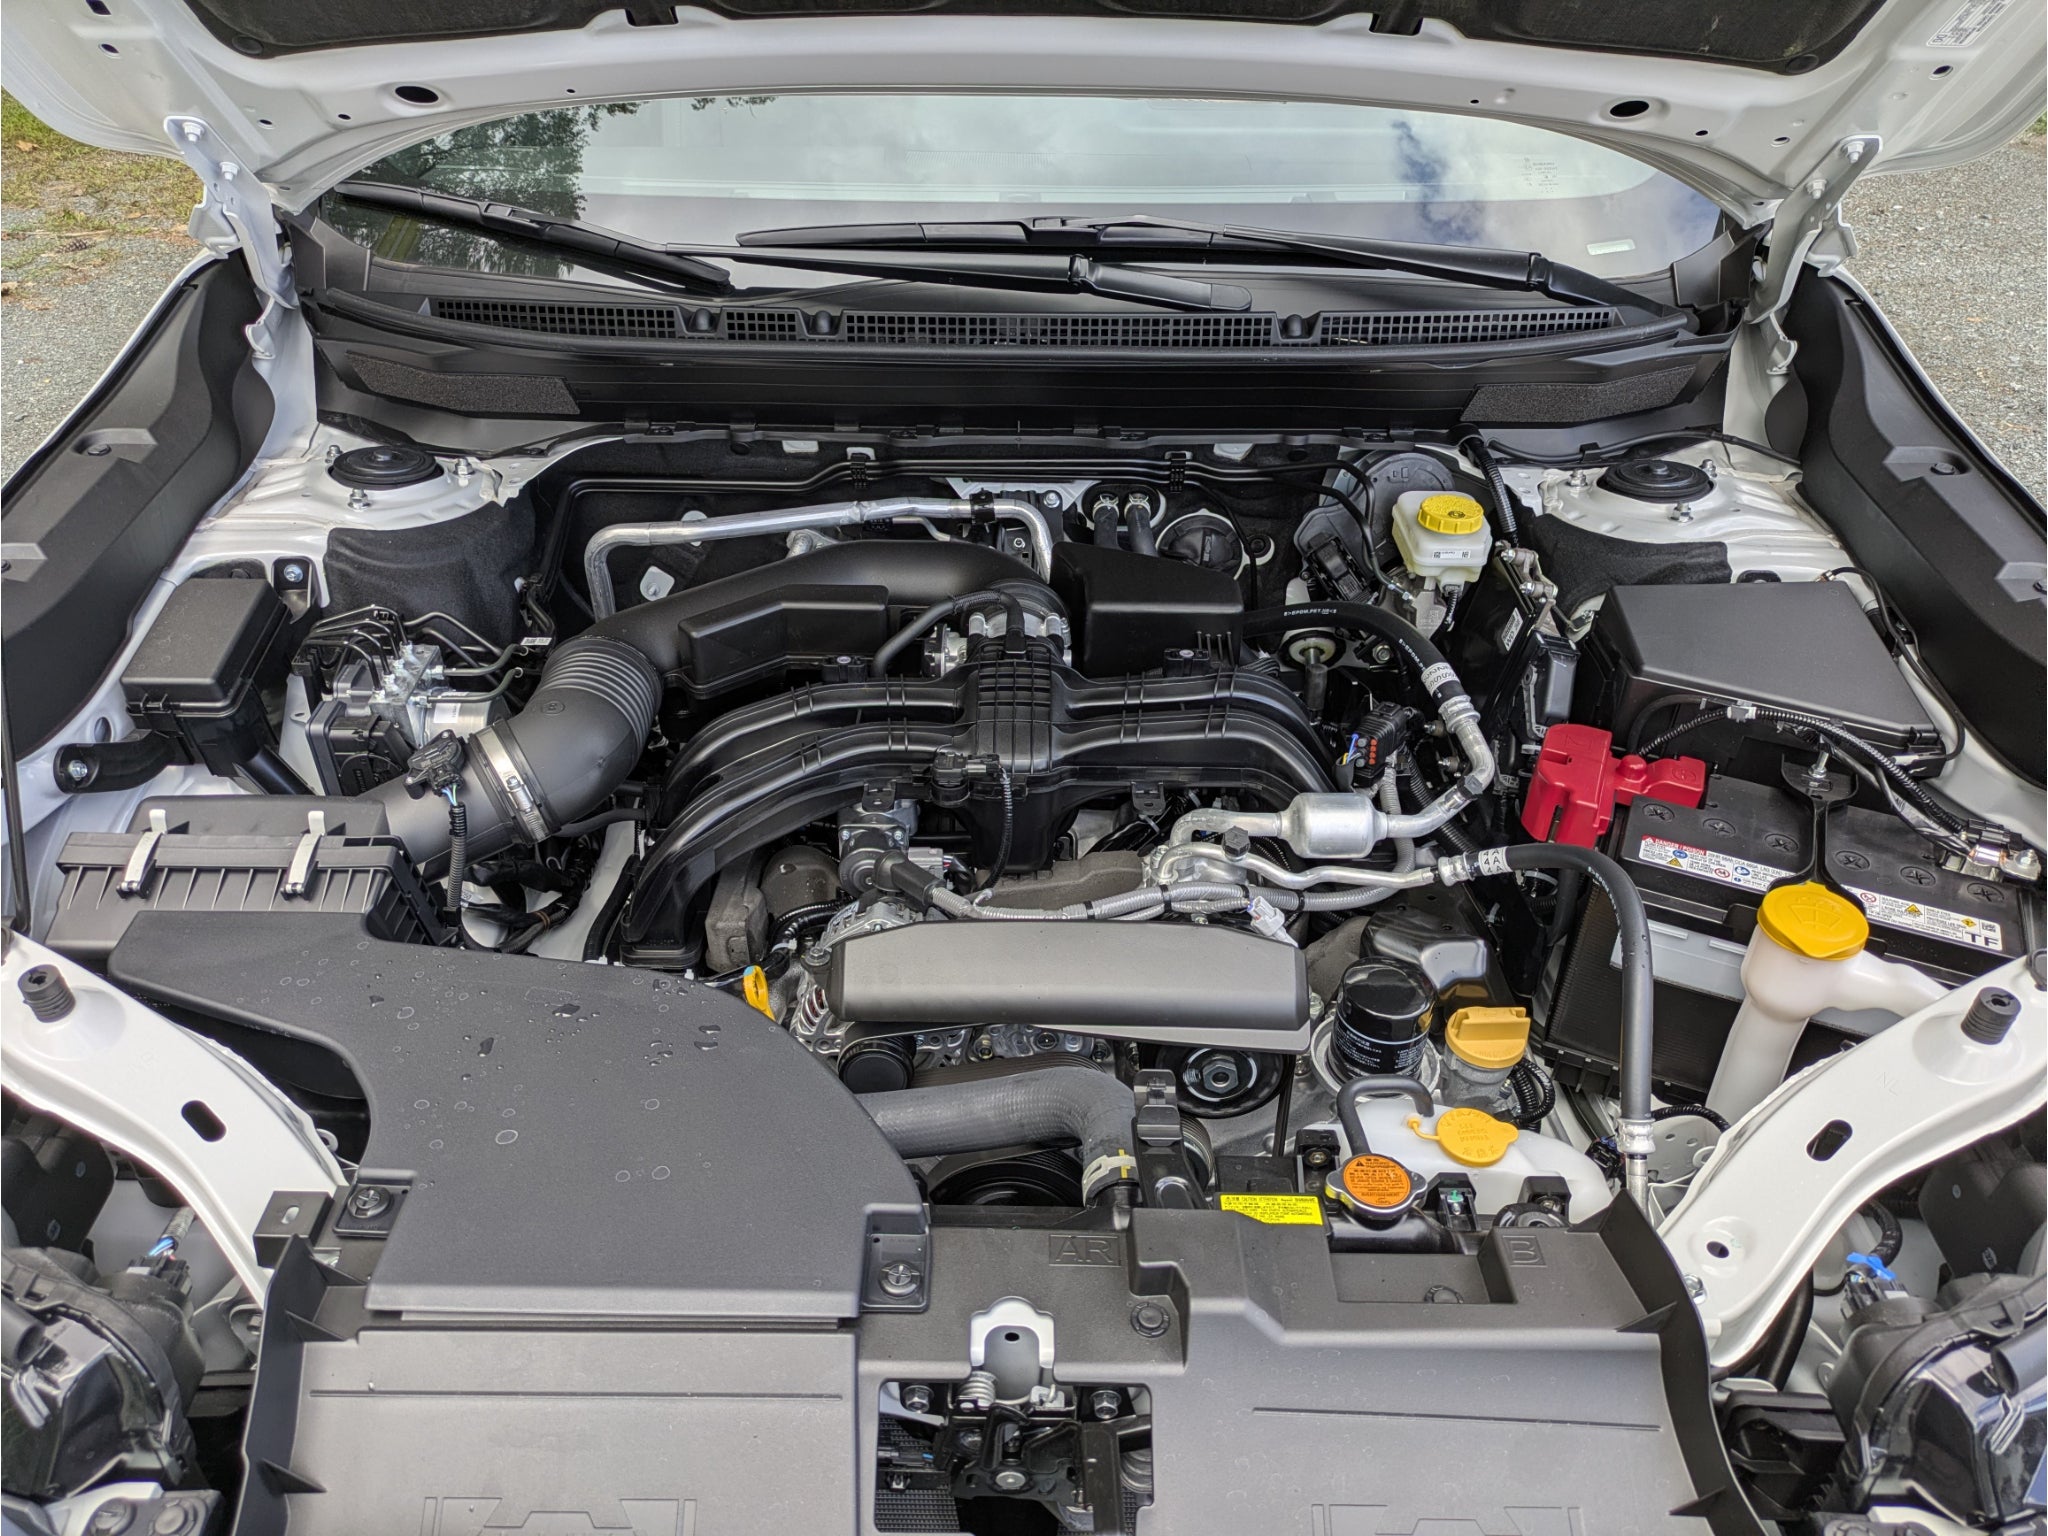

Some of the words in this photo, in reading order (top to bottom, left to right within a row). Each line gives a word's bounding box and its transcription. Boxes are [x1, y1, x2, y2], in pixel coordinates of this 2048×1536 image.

[1655, 839, 1679, 850] DANGER
[1682, 845, 1705, 855] POISON
[1965, 931, 1999, 947] TF
[1056, 1238, 1113, 1263] AR
[1509, 1240, 1540, 1264] B
